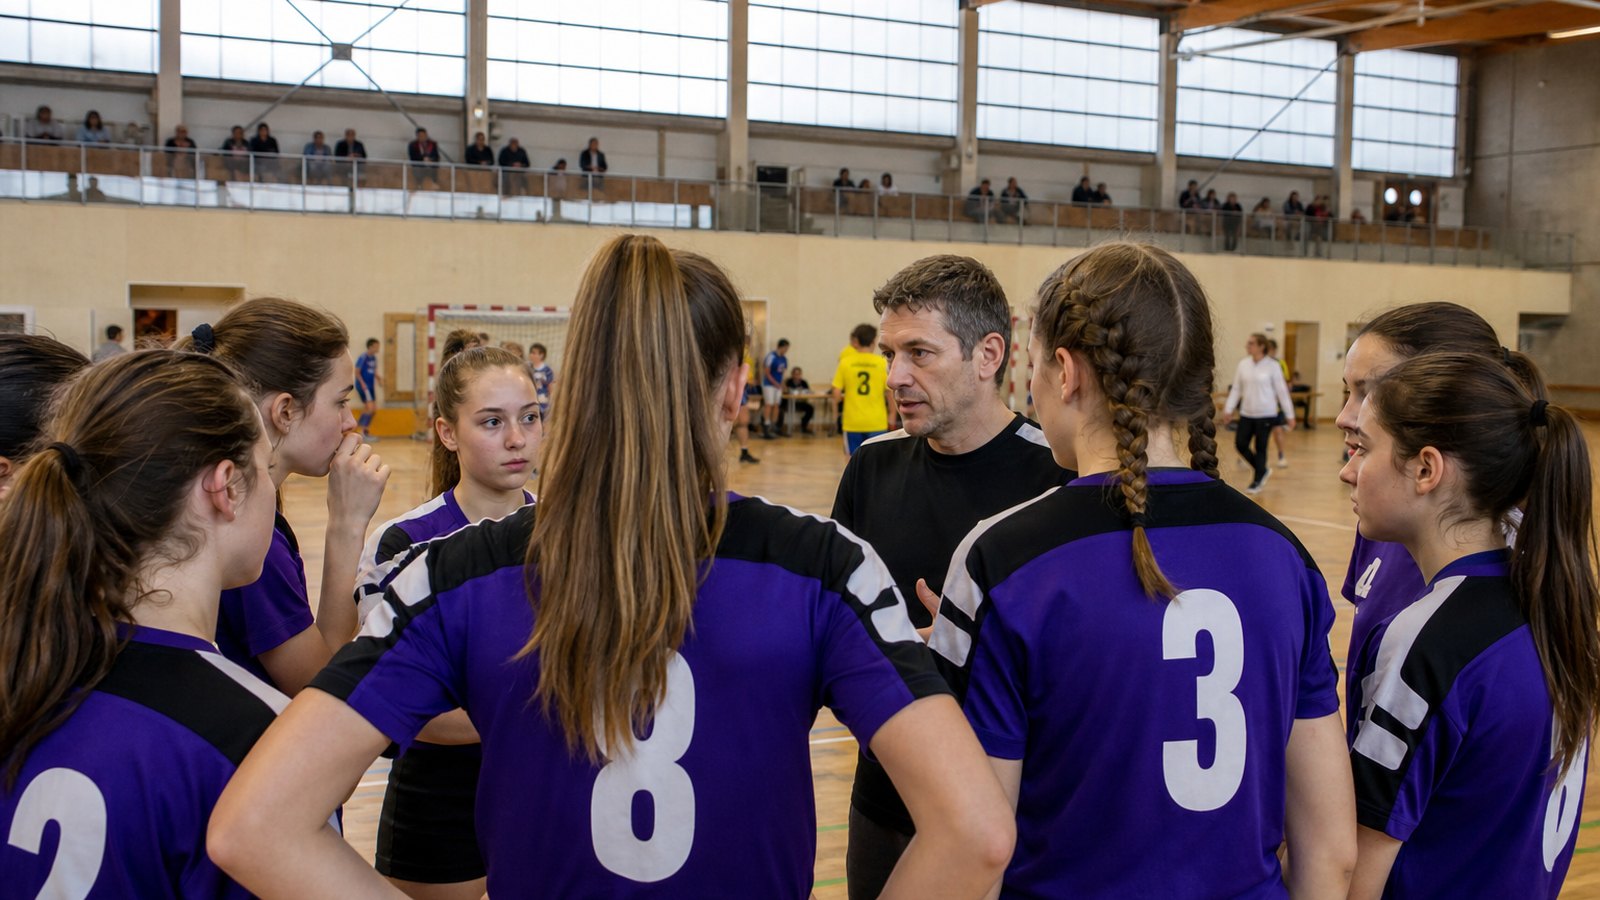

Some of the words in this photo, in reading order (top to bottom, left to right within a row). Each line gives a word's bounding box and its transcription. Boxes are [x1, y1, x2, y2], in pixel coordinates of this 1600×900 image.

[857, 371, 871, 396] 3
[1354, 557, 1382, 598] 4
[591, 648, 696, 883] 8
[1162, 588, 1247, 812] 3
[7, 767, 107, 900] 2
